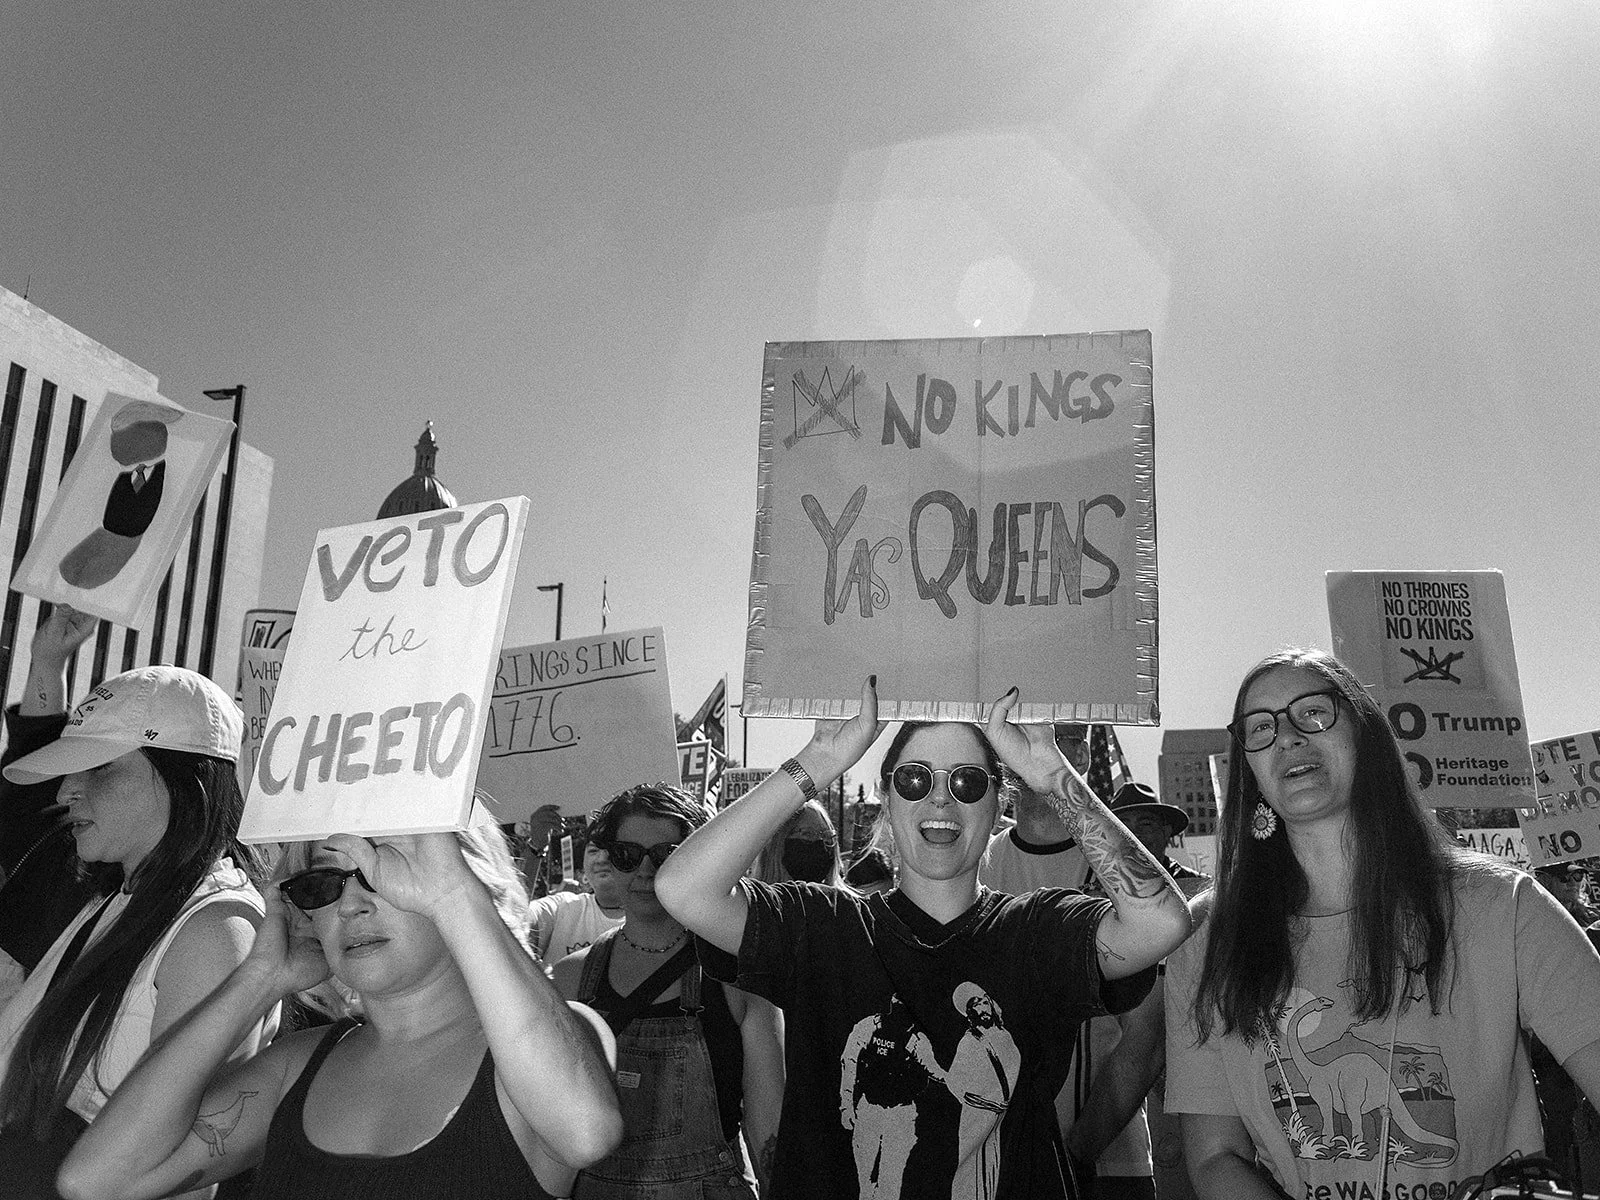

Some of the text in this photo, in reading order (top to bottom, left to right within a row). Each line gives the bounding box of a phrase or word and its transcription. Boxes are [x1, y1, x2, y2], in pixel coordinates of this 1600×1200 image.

[882, 370, 1122, 449] NO KINGS
[909, 490, 1126, 619] QUEENS
[1382, 581, 1469, 599] NO THRONES
[1384, 599, 1471, 617] NO CROWNS
[339, 616, 428, 661] the
[1386, 617, 1474, 640] NO KINGS
[576, 635, 656, 675] SINCE
[1432, 713, 1522, 736] Trump
[258, 693, 476, 796] CHEETO
[1436, 757, 1509, 772] Heritage
[1437, 774, 1532, 786] Foundation
[1538, 830, 1582, 859] NO
[872, 1036, 896, 1049] POLICE
[877, 1047, 888, 1055] ICE
